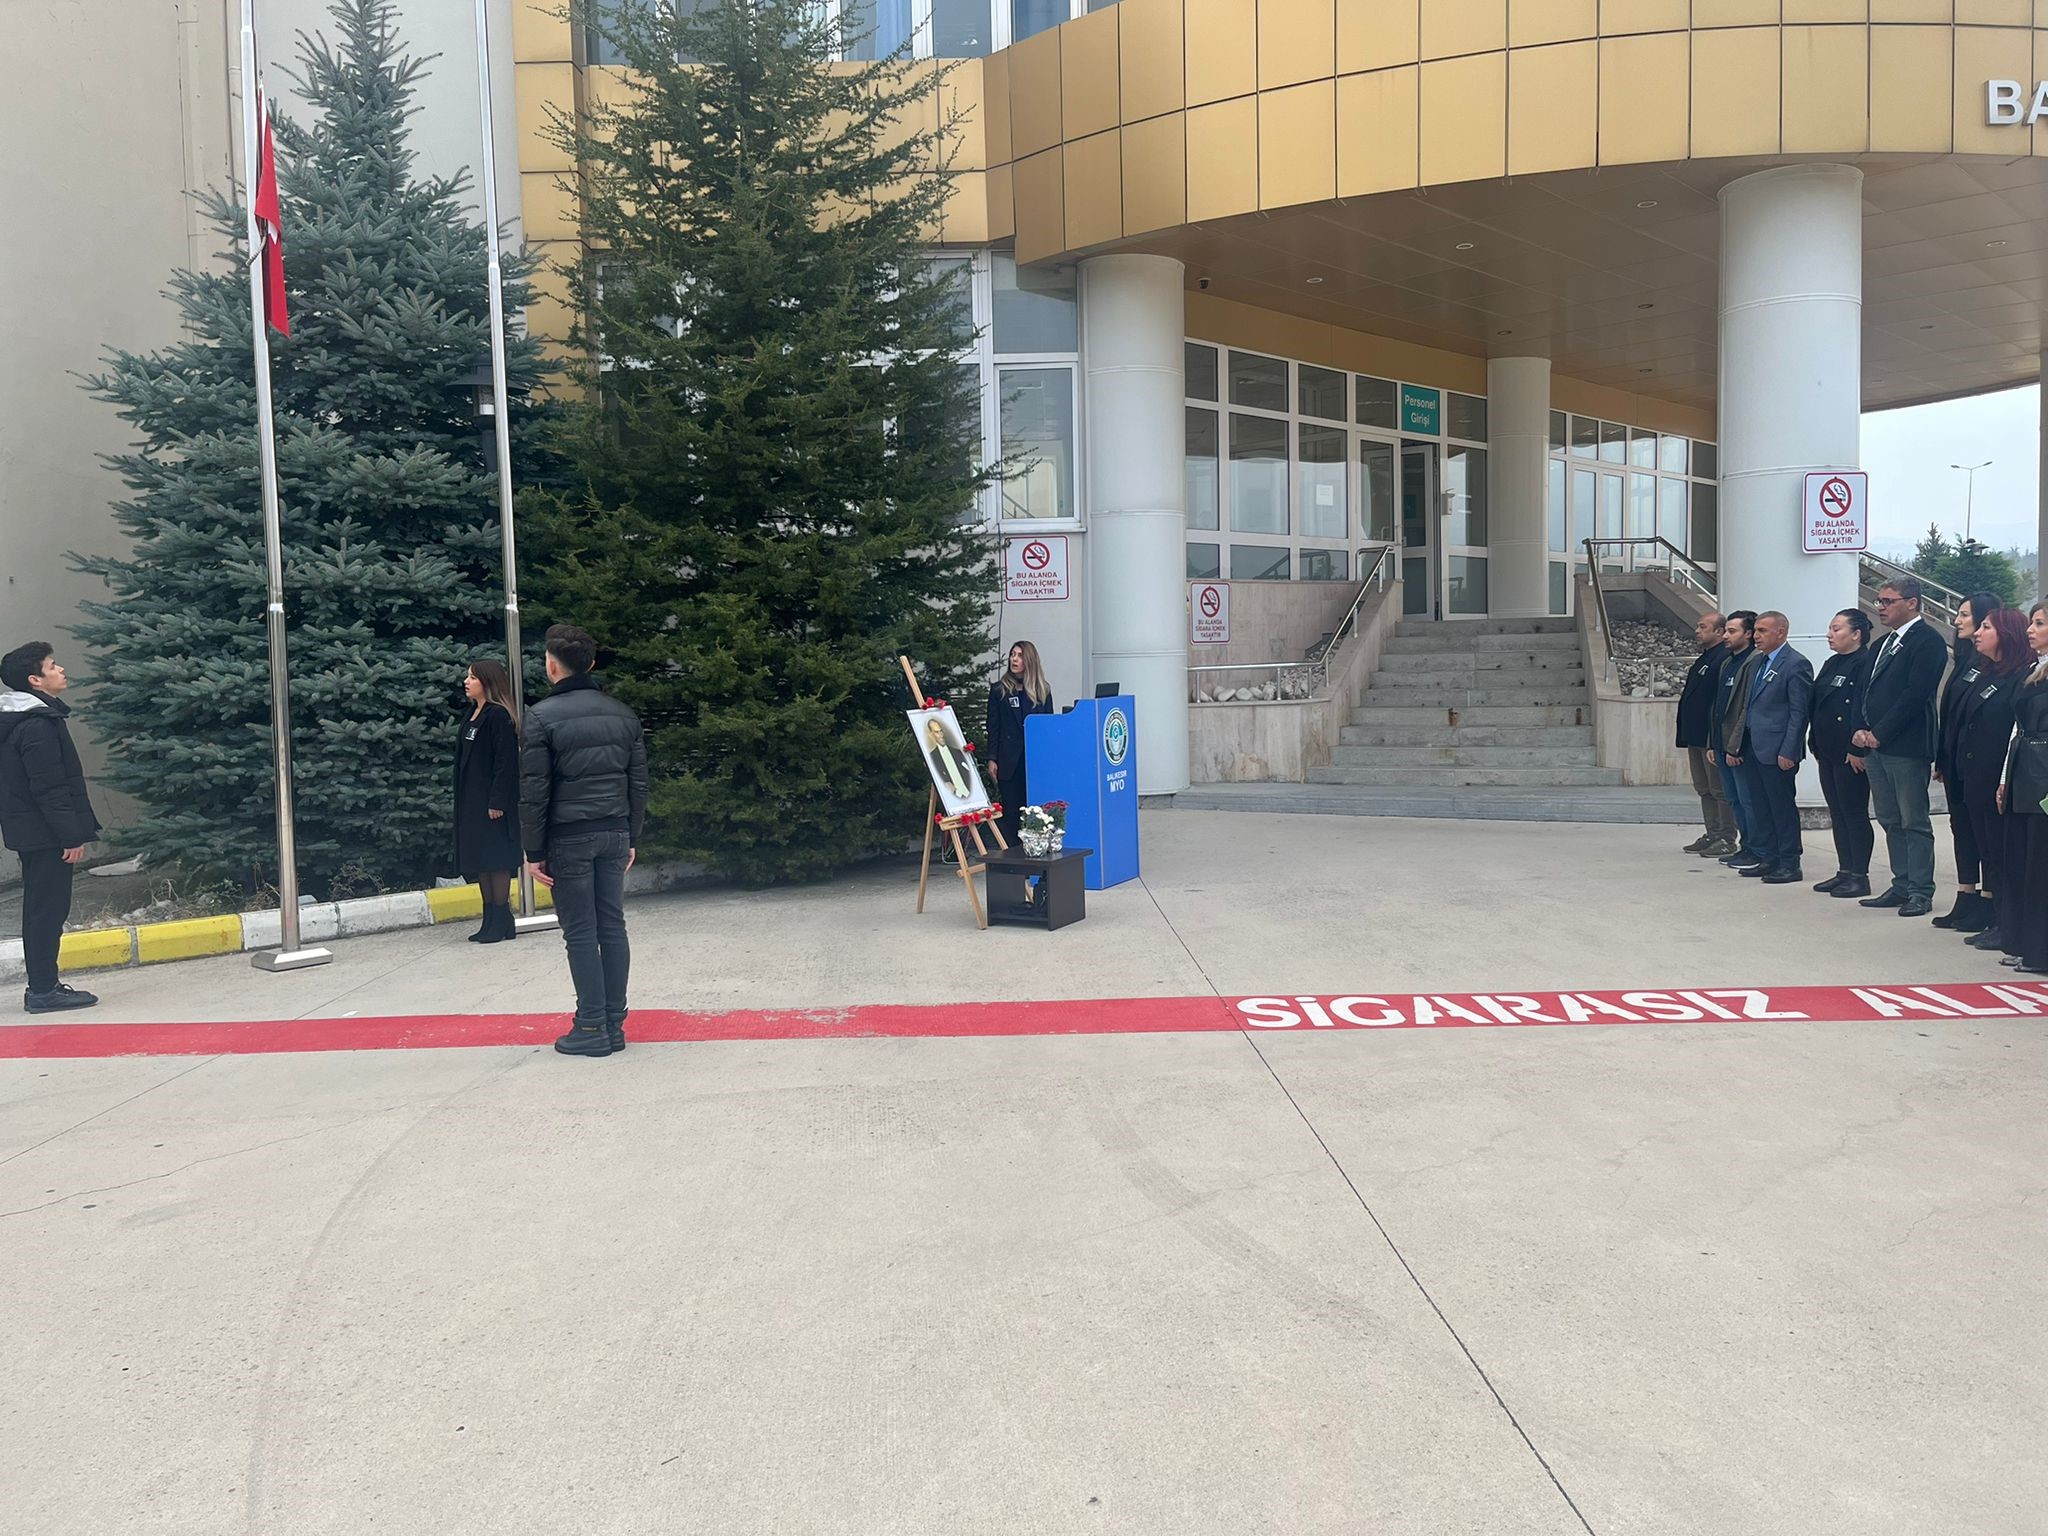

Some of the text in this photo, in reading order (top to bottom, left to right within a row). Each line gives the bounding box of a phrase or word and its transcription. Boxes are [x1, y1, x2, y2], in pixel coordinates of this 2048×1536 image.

[1404, 394, 1436, 410] Personel
[1410, 412, 1430, 428] Girişi
[1815, 520, 1855, 528] BU ALANDA
[1818, 537, 1853, 545] YASAKTIR
[1028, 571, 1058, 579] ALANDA
[1110, 779, 1125, 792] MYO
[1848, 984, 2048, 1017] ALA
